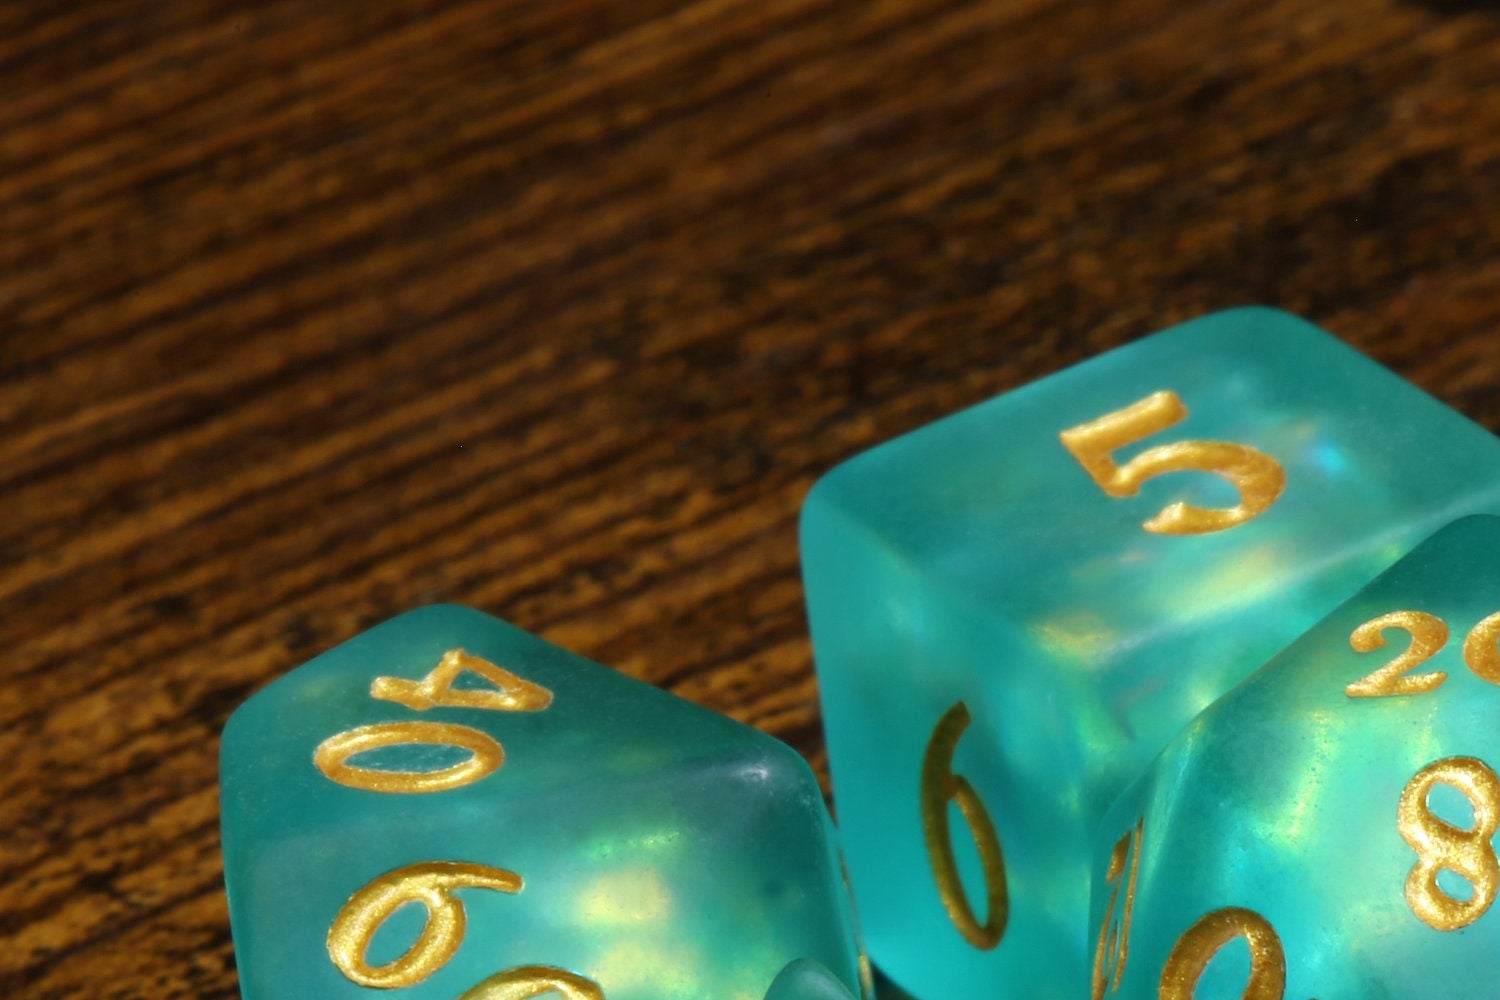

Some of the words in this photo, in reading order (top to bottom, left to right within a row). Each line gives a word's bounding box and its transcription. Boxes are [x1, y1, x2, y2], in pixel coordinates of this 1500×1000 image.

[1059, 391, 1286, 536] 5
[313, 648, 554, 793] 40
[920, 700, 1010, 952] 6
